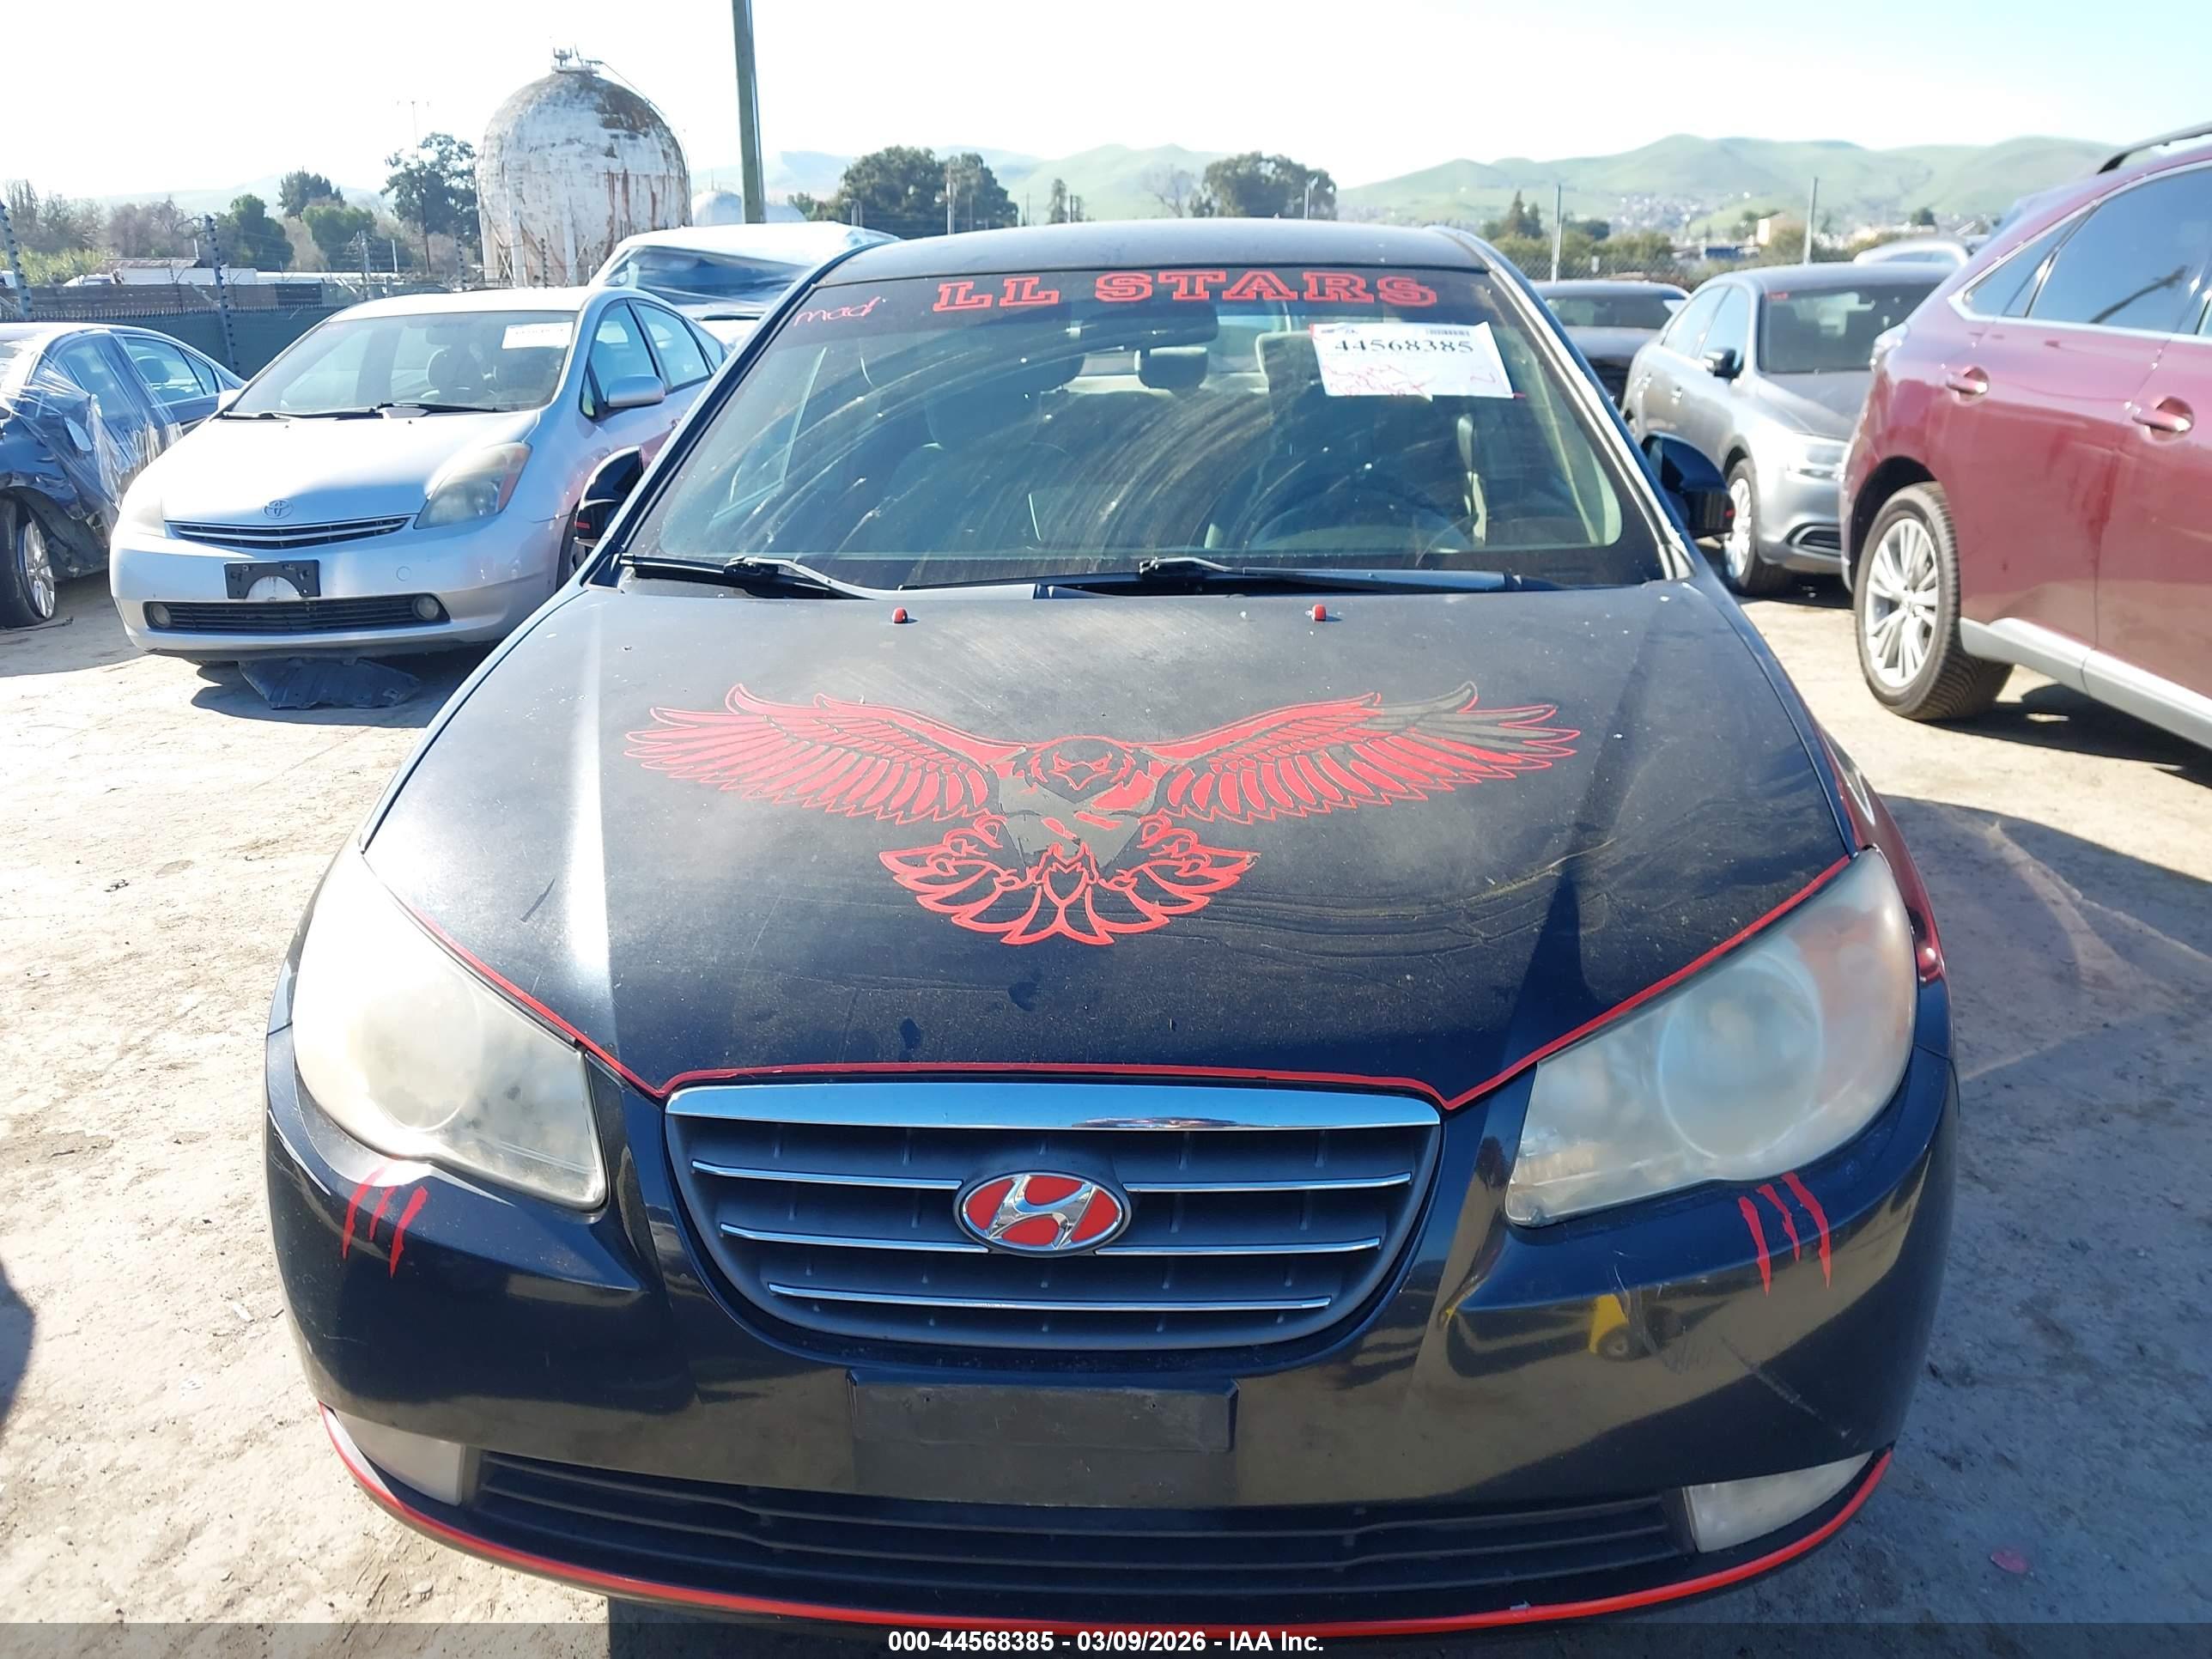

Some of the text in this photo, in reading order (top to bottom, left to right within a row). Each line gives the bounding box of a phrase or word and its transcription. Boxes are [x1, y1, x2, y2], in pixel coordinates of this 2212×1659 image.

[933, 270, 1437, 312] LL STARS
[1334, 339, 1474, 354] 44568385
